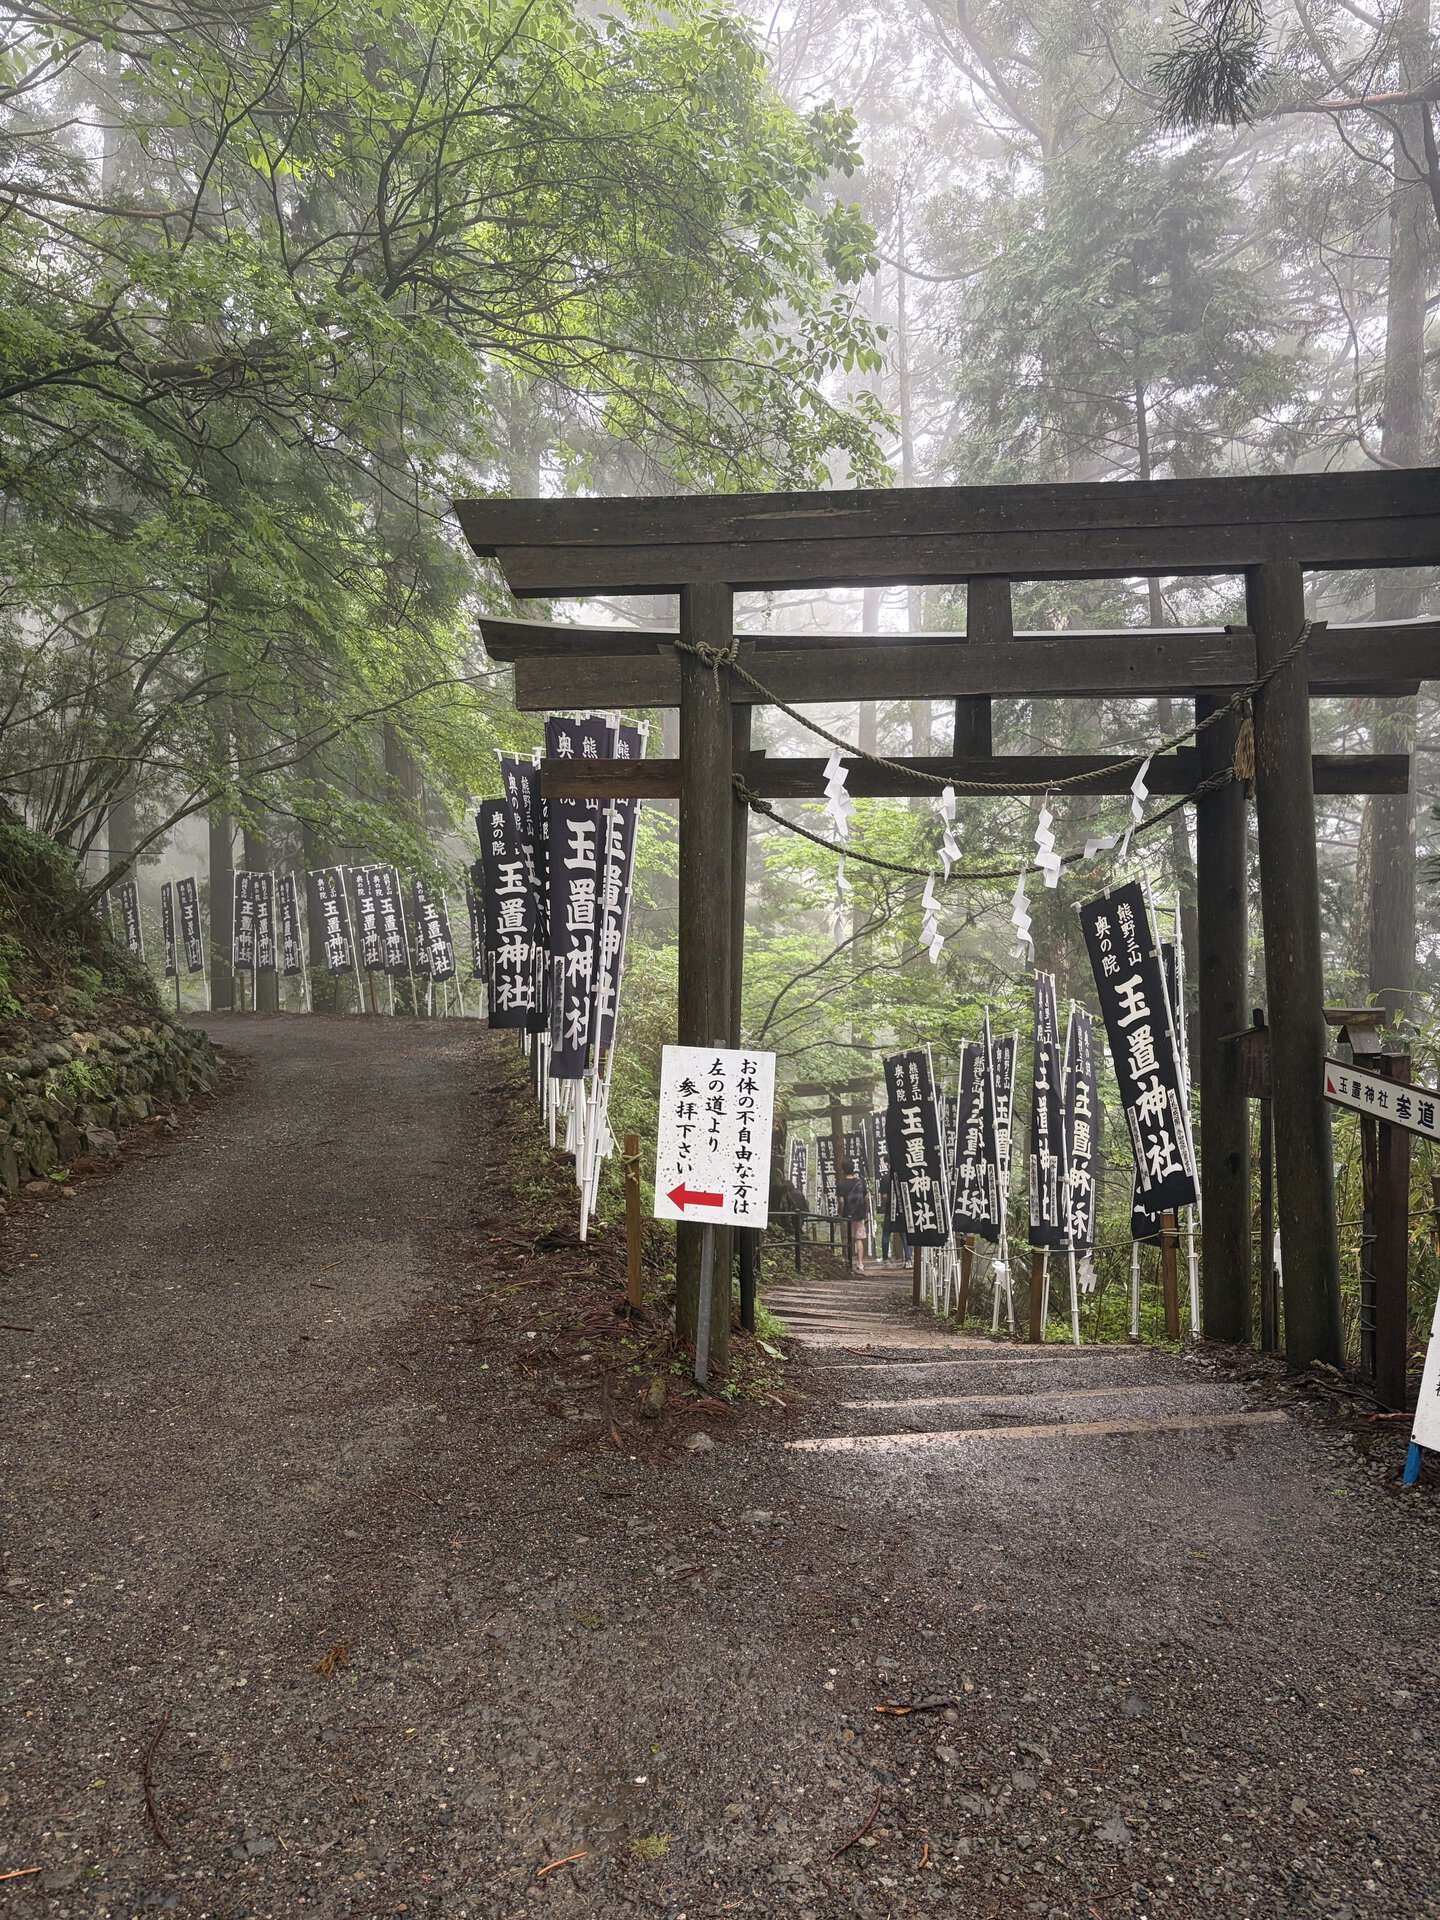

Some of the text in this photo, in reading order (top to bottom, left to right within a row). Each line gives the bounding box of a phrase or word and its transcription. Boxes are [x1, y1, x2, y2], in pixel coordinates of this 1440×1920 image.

[491, 811, 506, 856] 奥の院
[258, 902, 269, 966] 玉置神社
[324, 900, 346, 968] 玉置神社
[361, 897, 379, 965] 玉置神社
[380, 898, 403, 966] 玉置神社
[423, 903, 450, 974] 玉置神社
[494, 861, 530, 1013] 玉置神社
[563, 819, 597, 1051] 玉置神社
[1094, 915, 1121, 978] 奥の院
[1116, 902, 1143, 967] 熊野三山
[705, 1057, 728, 1153] 左の道より
[893, 1064, 907, 1102] 奥の院
[908, 1062, 922, 1101] 熊野三山
[1113, 973, 1184, 1185] 玉置神社
[1338, 1076, 1389, 1109] 玉置神社
[675, 1077, 700, 1175] 参拝下さい
[732, 1058, 760, 1215] お体の不自由な方は
[901, 1106, 937, 1232] 玉置神社
